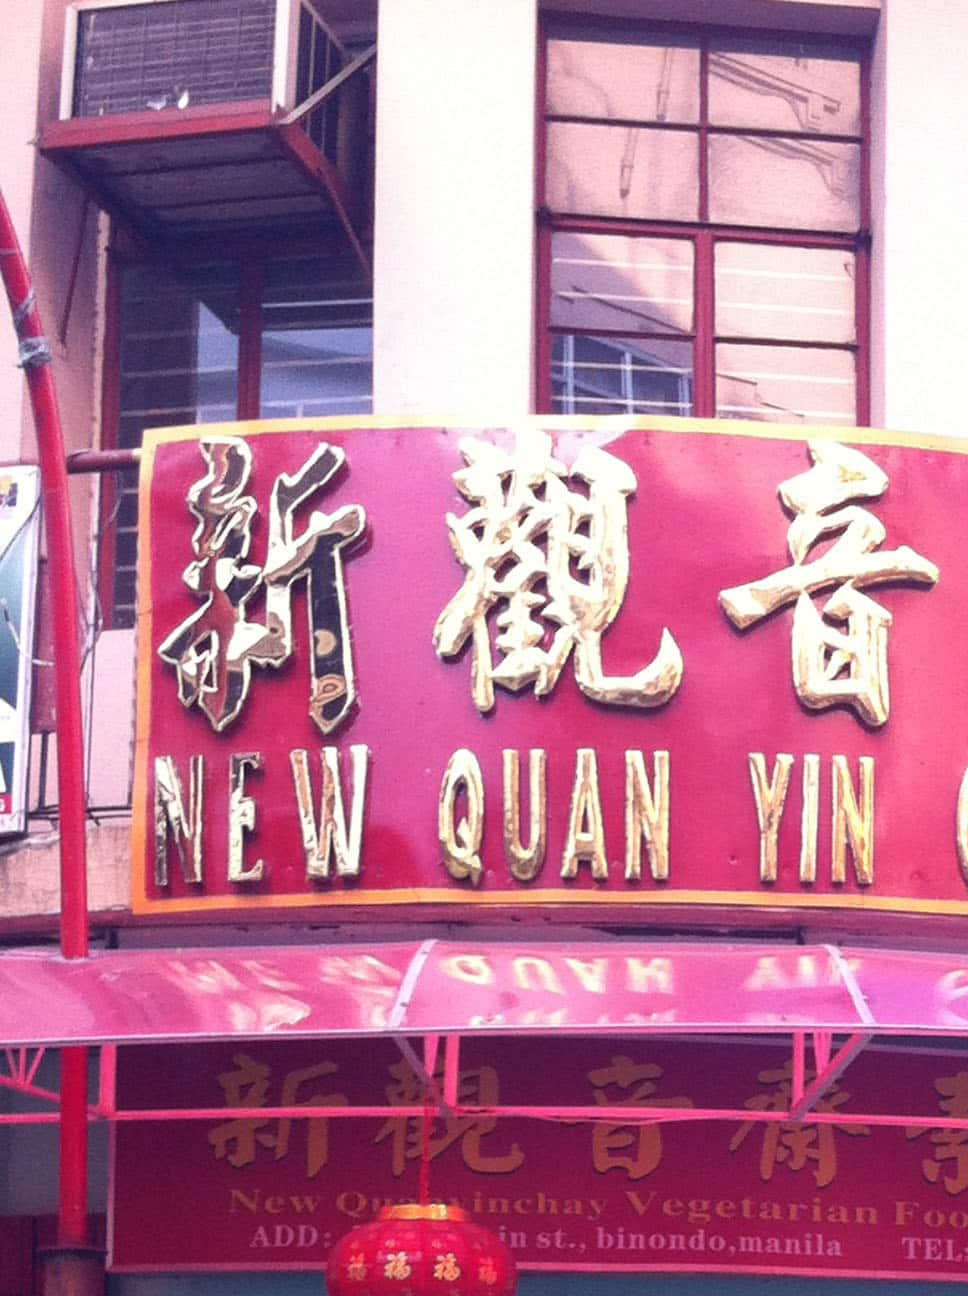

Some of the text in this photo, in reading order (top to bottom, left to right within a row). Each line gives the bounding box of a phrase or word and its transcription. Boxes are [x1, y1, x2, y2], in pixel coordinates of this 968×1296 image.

[153, 745, 370, 887] NEW
[437, 748, 671, 886] QUAN
[748, 752, 875, 886] YIN
[229, 1189, 319, 1215] New
[625, 1189, 878, 1226] Vegetarian
[249, 1225, 331, 1249] ADD:
